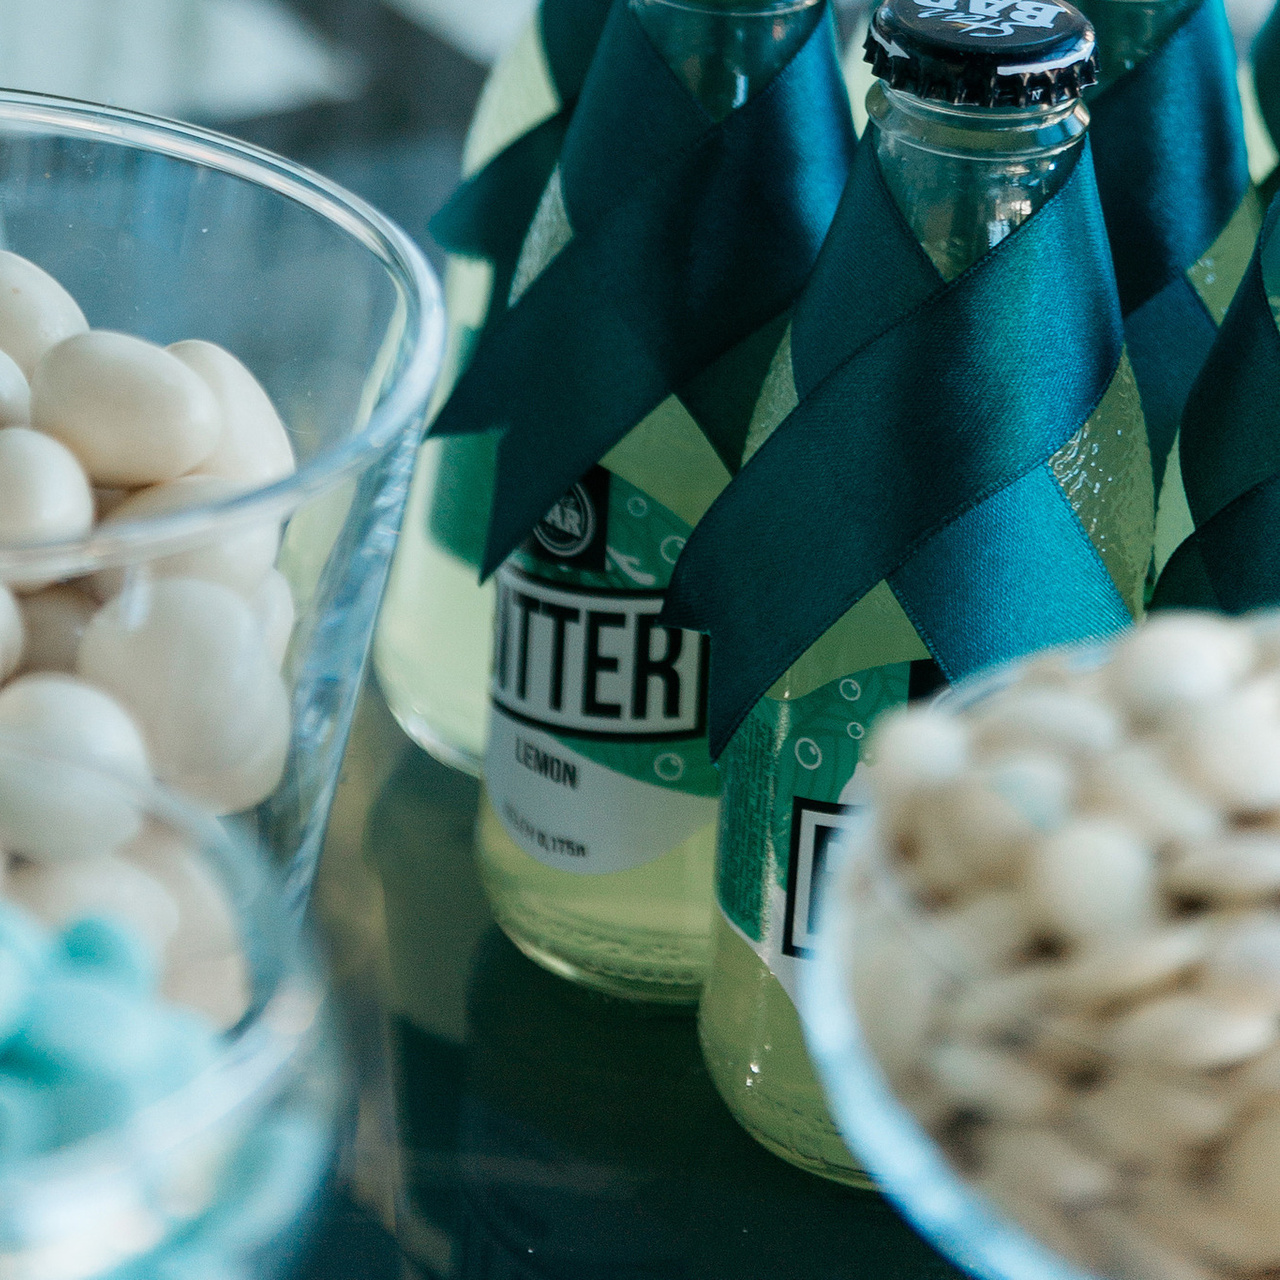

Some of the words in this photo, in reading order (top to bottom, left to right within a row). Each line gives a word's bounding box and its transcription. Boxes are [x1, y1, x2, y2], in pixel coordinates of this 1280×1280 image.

[917, 8, 1015, 38] Star
[543, 502, 582, 537] AR
[498, 588, 681, 721] ITTER
[515, 738, 577, 789] LEMON
